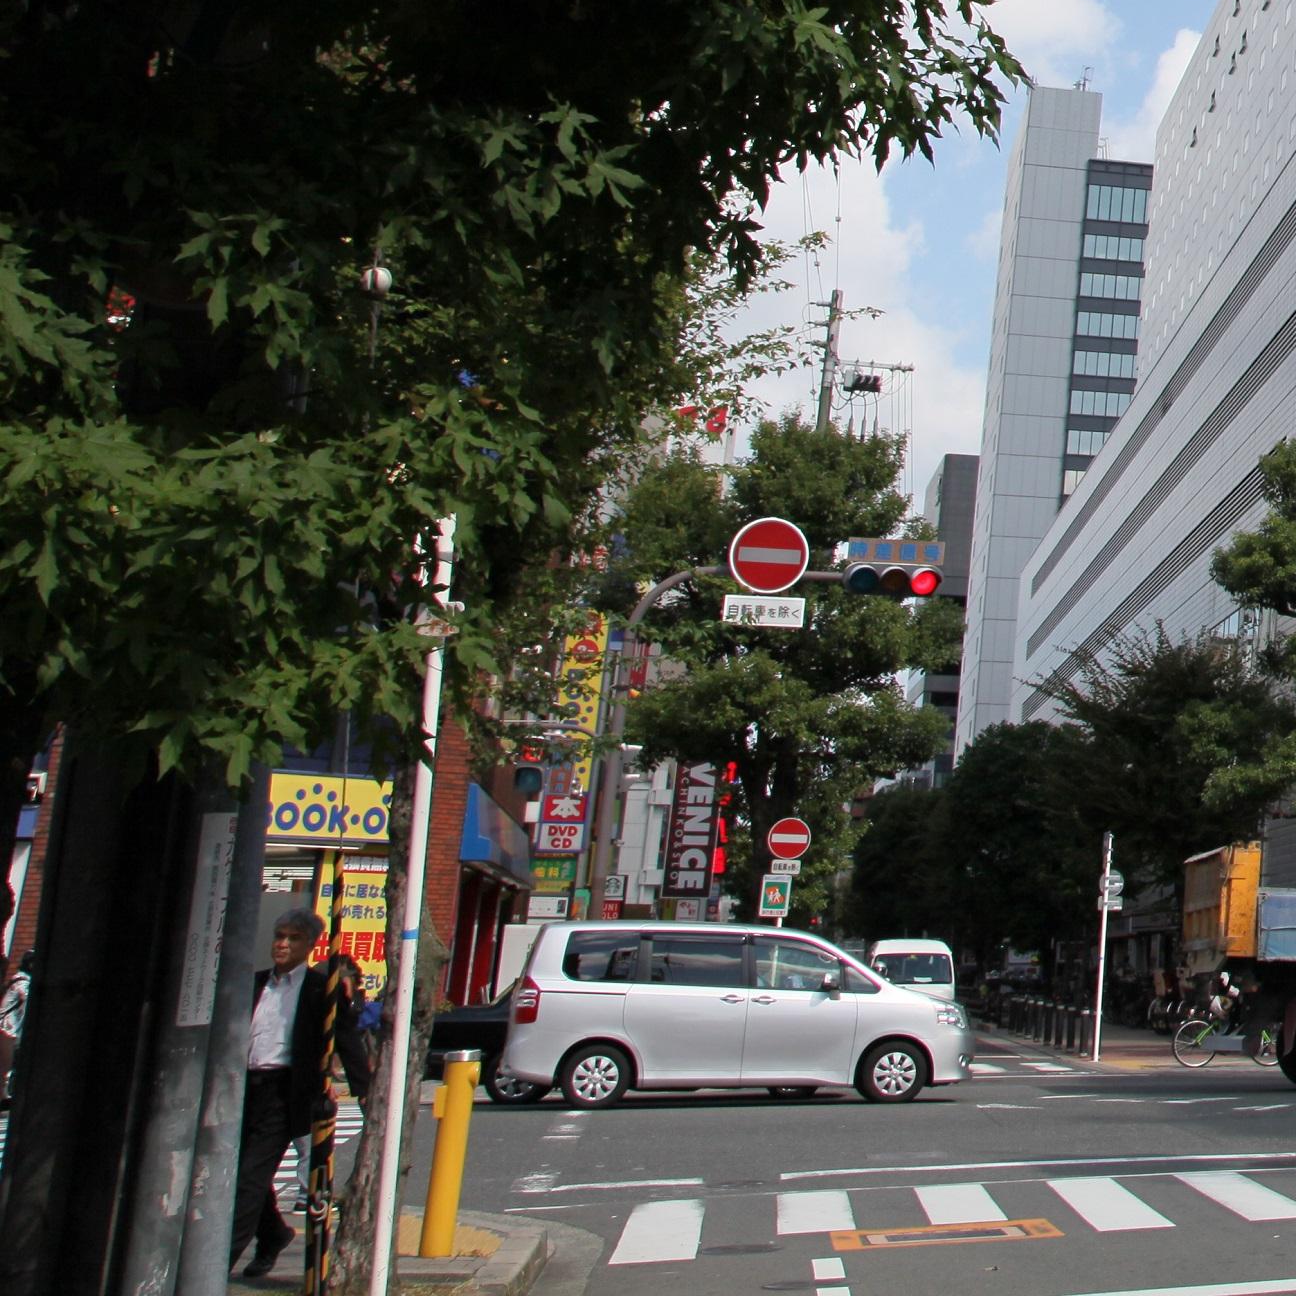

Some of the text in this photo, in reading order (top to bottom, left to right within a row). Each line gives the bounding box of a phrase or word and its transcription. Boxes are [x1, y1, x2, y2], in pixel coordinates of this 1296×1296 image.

[727, 603, 801, 618] 自転車を除く
[550, 796, 581, 818] 本
[547, 825, 578, 837] DVD
[668, 763, 692, 889] ACHINKO&SLOT
[676, 761, 717, 890] VENICE
[550, 838, 572, 849] CD
